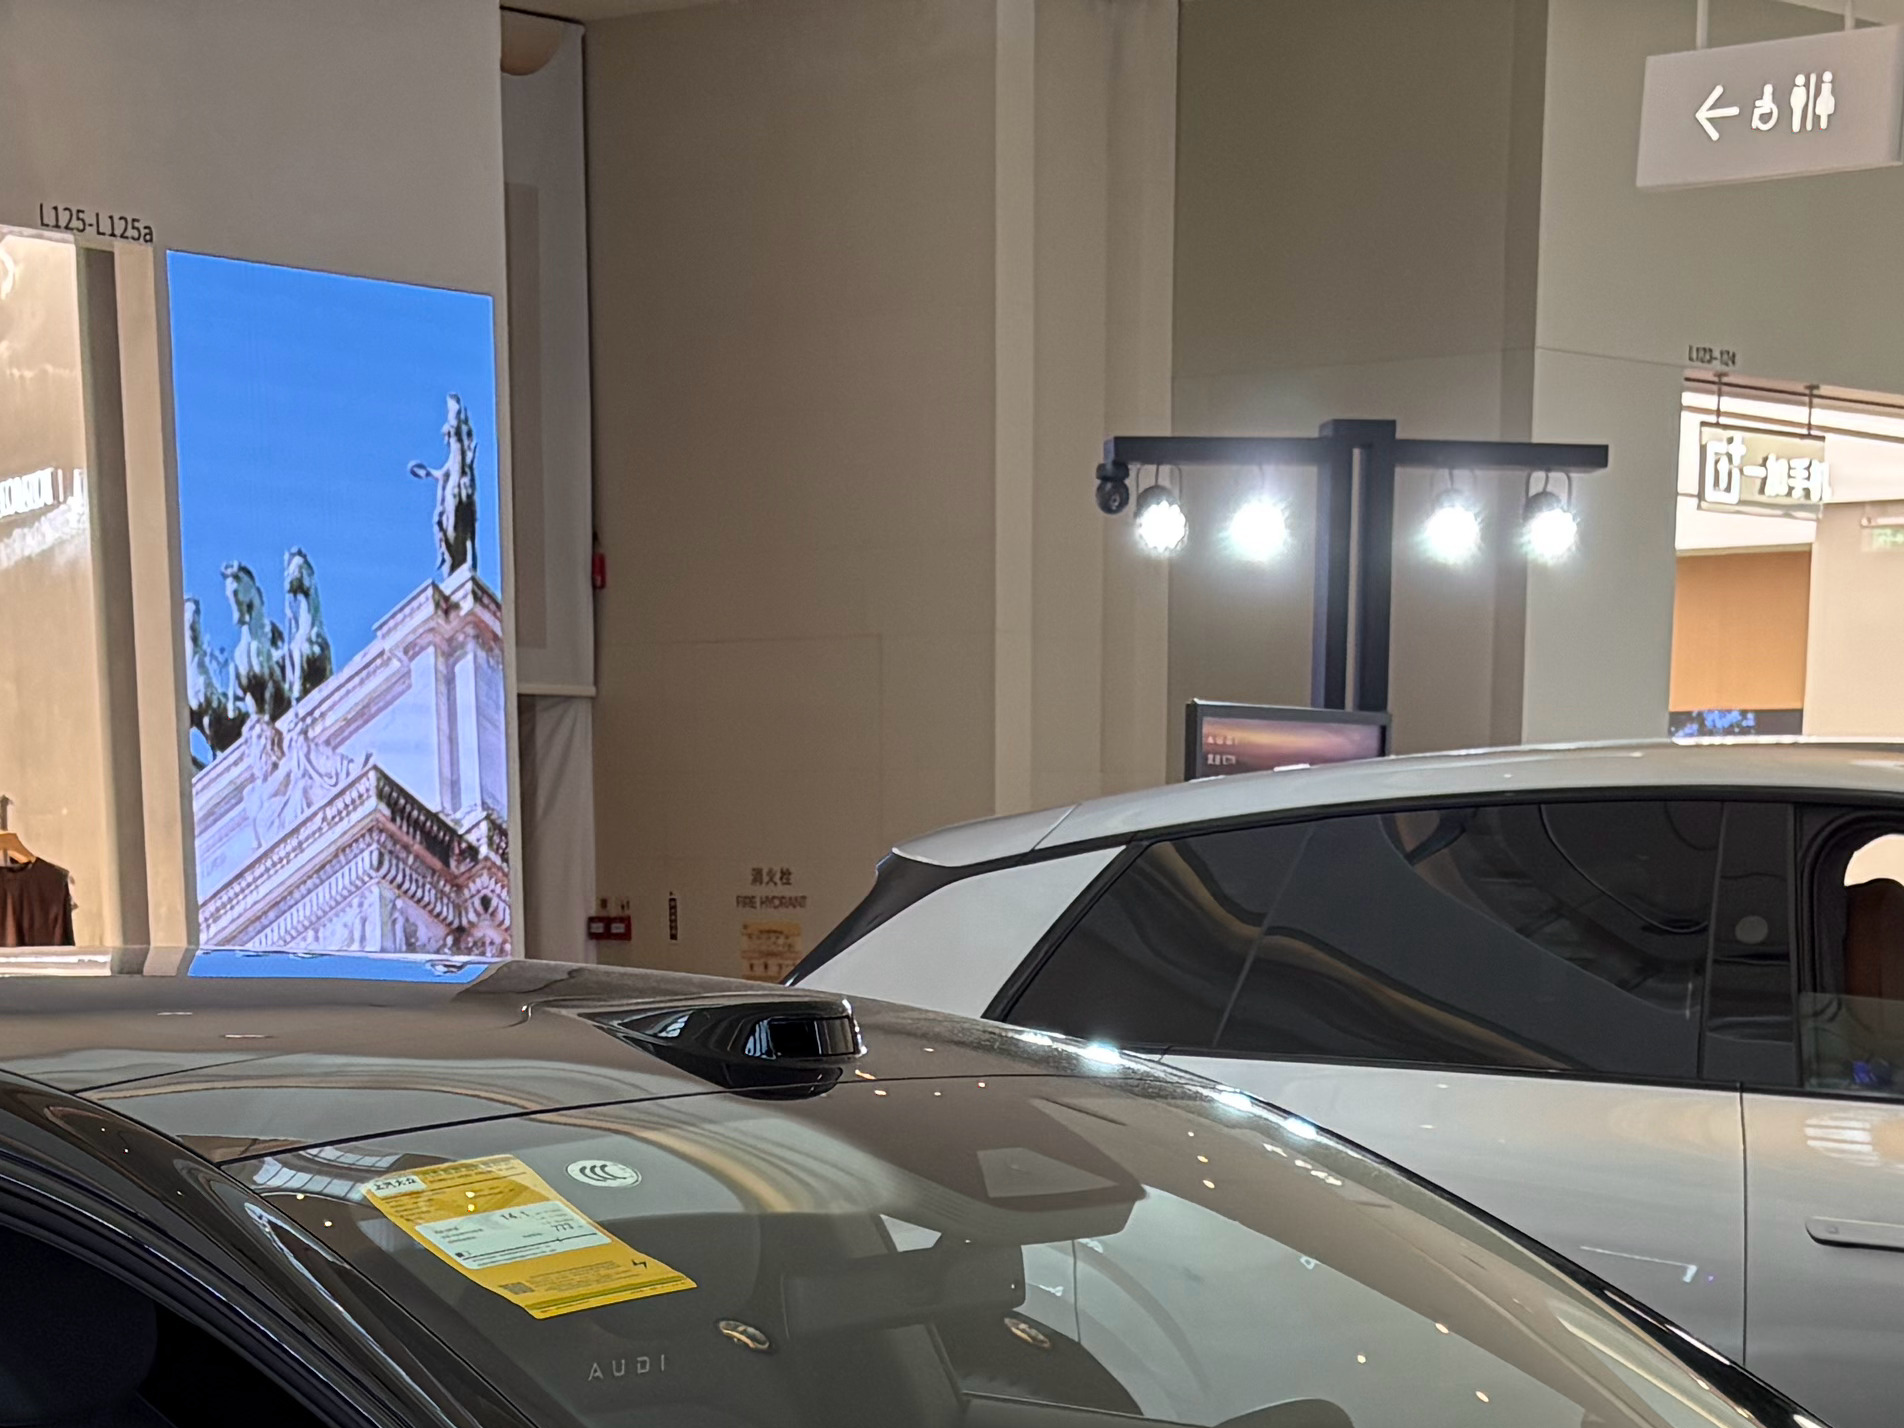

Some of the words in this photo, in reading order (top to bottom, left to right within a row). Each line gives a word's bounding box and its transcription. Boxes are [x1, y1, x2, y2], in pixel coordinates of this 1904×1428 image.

[39, 202, 154, 243] L125-L125a
[750, 867, 793, 886] 消火栓
[735, 895, 757, 909] FIRE
[759, 895, 807, 910] HYDRANT
[587, 1354, 665, 1381] AUDI
